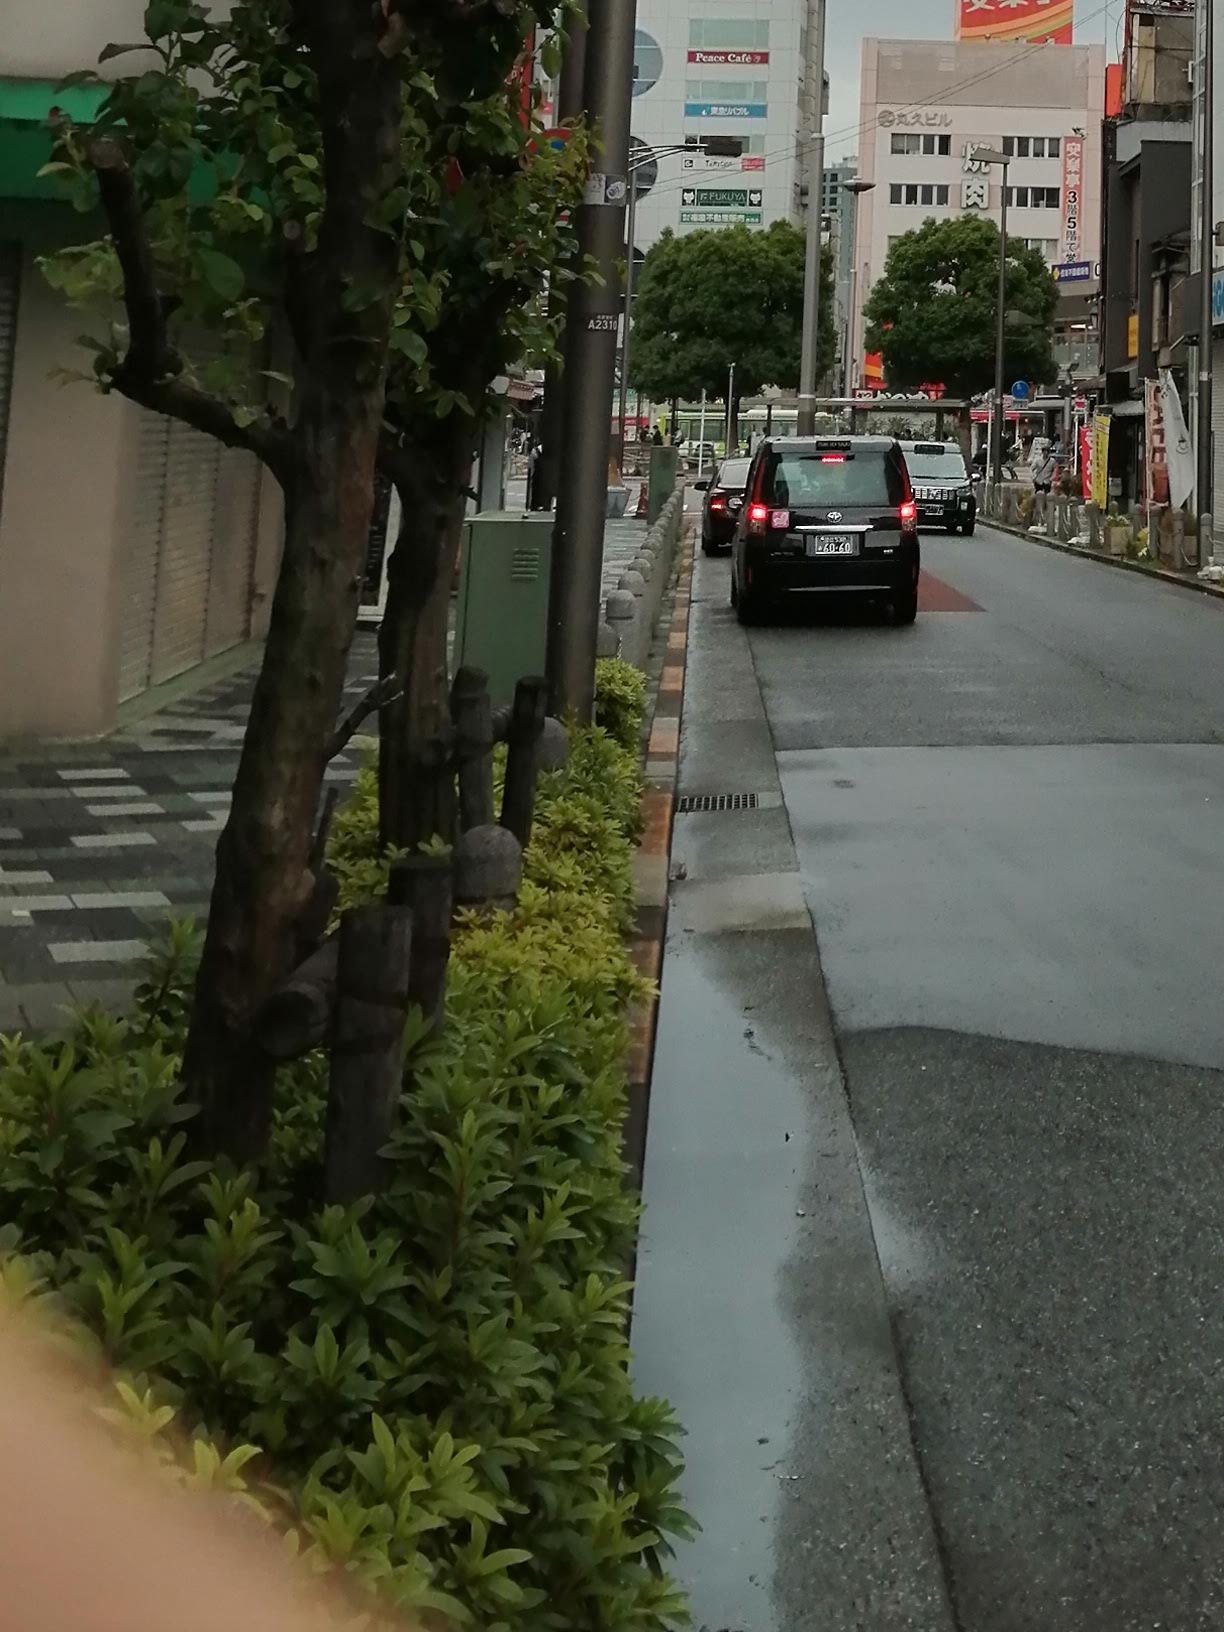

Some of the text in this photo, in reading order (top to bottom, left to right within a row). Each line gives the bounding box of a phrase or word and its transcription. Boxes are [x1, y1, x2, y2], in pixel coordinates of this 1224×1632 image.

[696, 52, 725, 63] Peace
[896, 112, 951, 128] 丸久ビル
[709, 191, 746, 202] FUKUYA
[588, 320, 617, 331] A2310
